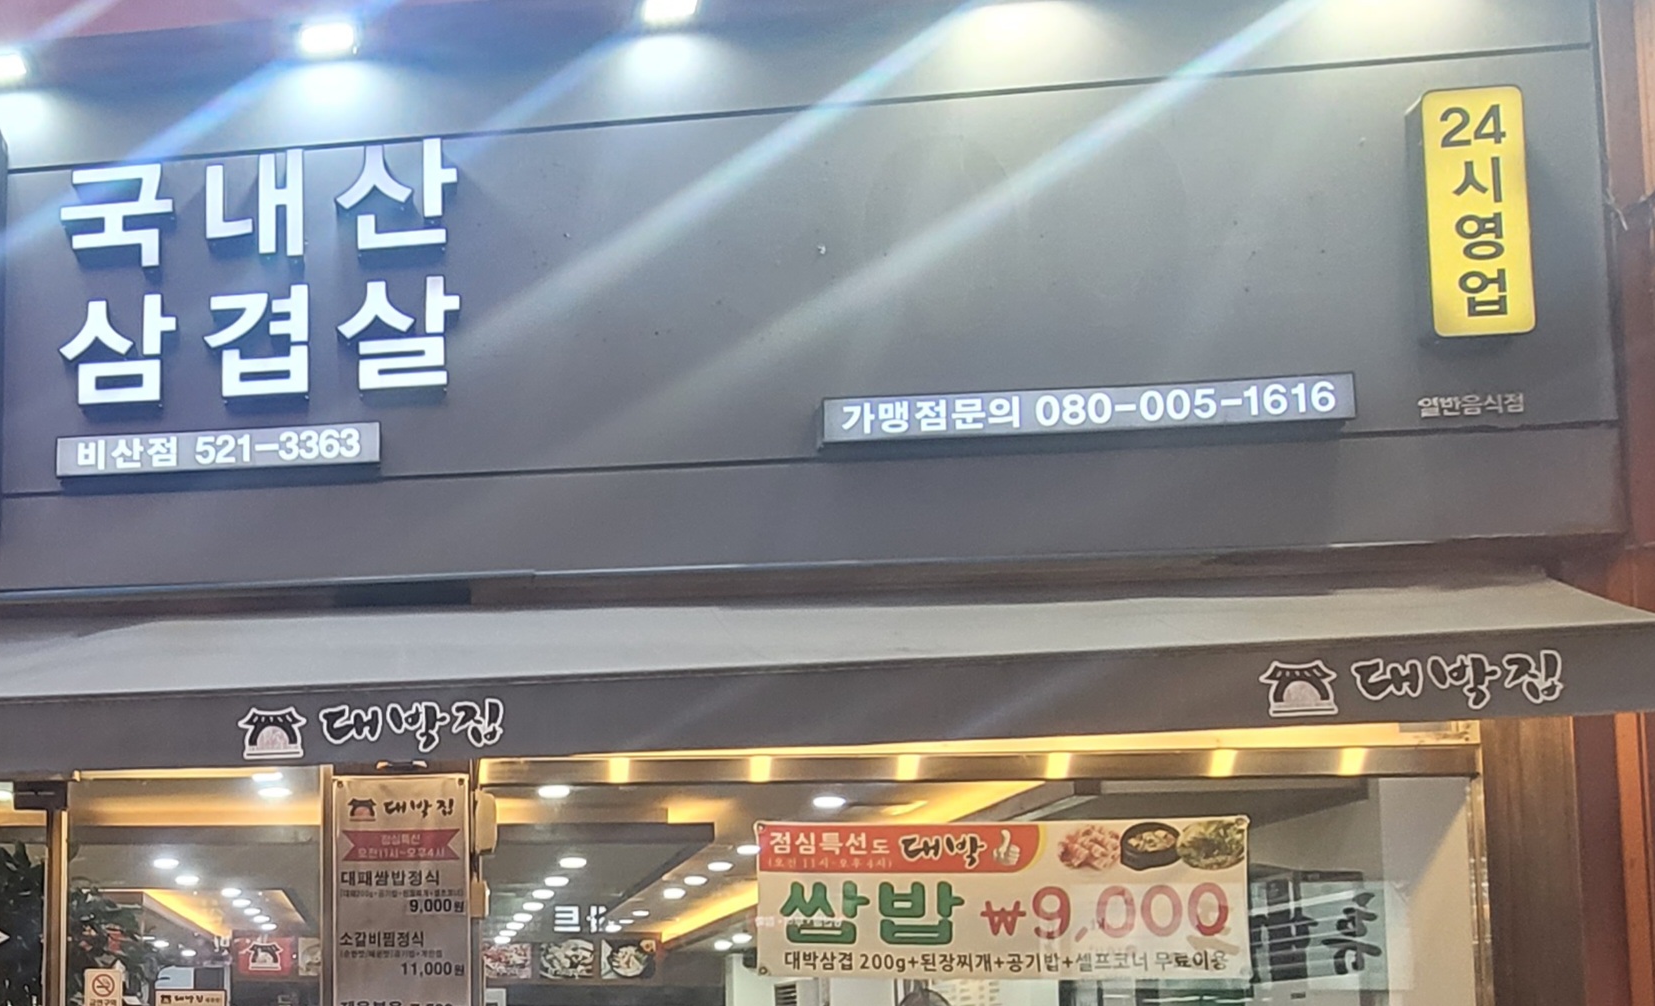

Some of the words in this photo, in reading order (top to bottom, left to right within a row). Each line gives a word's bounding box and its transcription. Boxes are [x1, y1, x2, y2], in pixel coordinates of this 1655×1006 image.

[60, 138, 458, 267] 국내산
[59, 275, 461, 405] 삼겹살
[841, 395, 1021, 435] 가맹점문의
[1035, 381, 1336, 427] 080-005-1616
[1418, 393, 1525, 418] 일반음식점
[77, 436, 178, 469] 비산점
[195, 428, 361, 465] 521-3363
[1350, 650, 1563, 709] 대박집
[319, 698, 504, 753] 대박집
[383, 798, 455, 818] 대박집
[769, 832, 890, 854] 점심특선도
[899, 833, 987, 869] 대박
[340, 869, 441, 887] 대패쌈밥정식
[779, 880, 965, 945] 쌈밥
[401, 962, 465, 978] 11,000원
[784, 951, 854, 972] 대박삼겹
[1154, 950, 1229, 971] 무료이용
